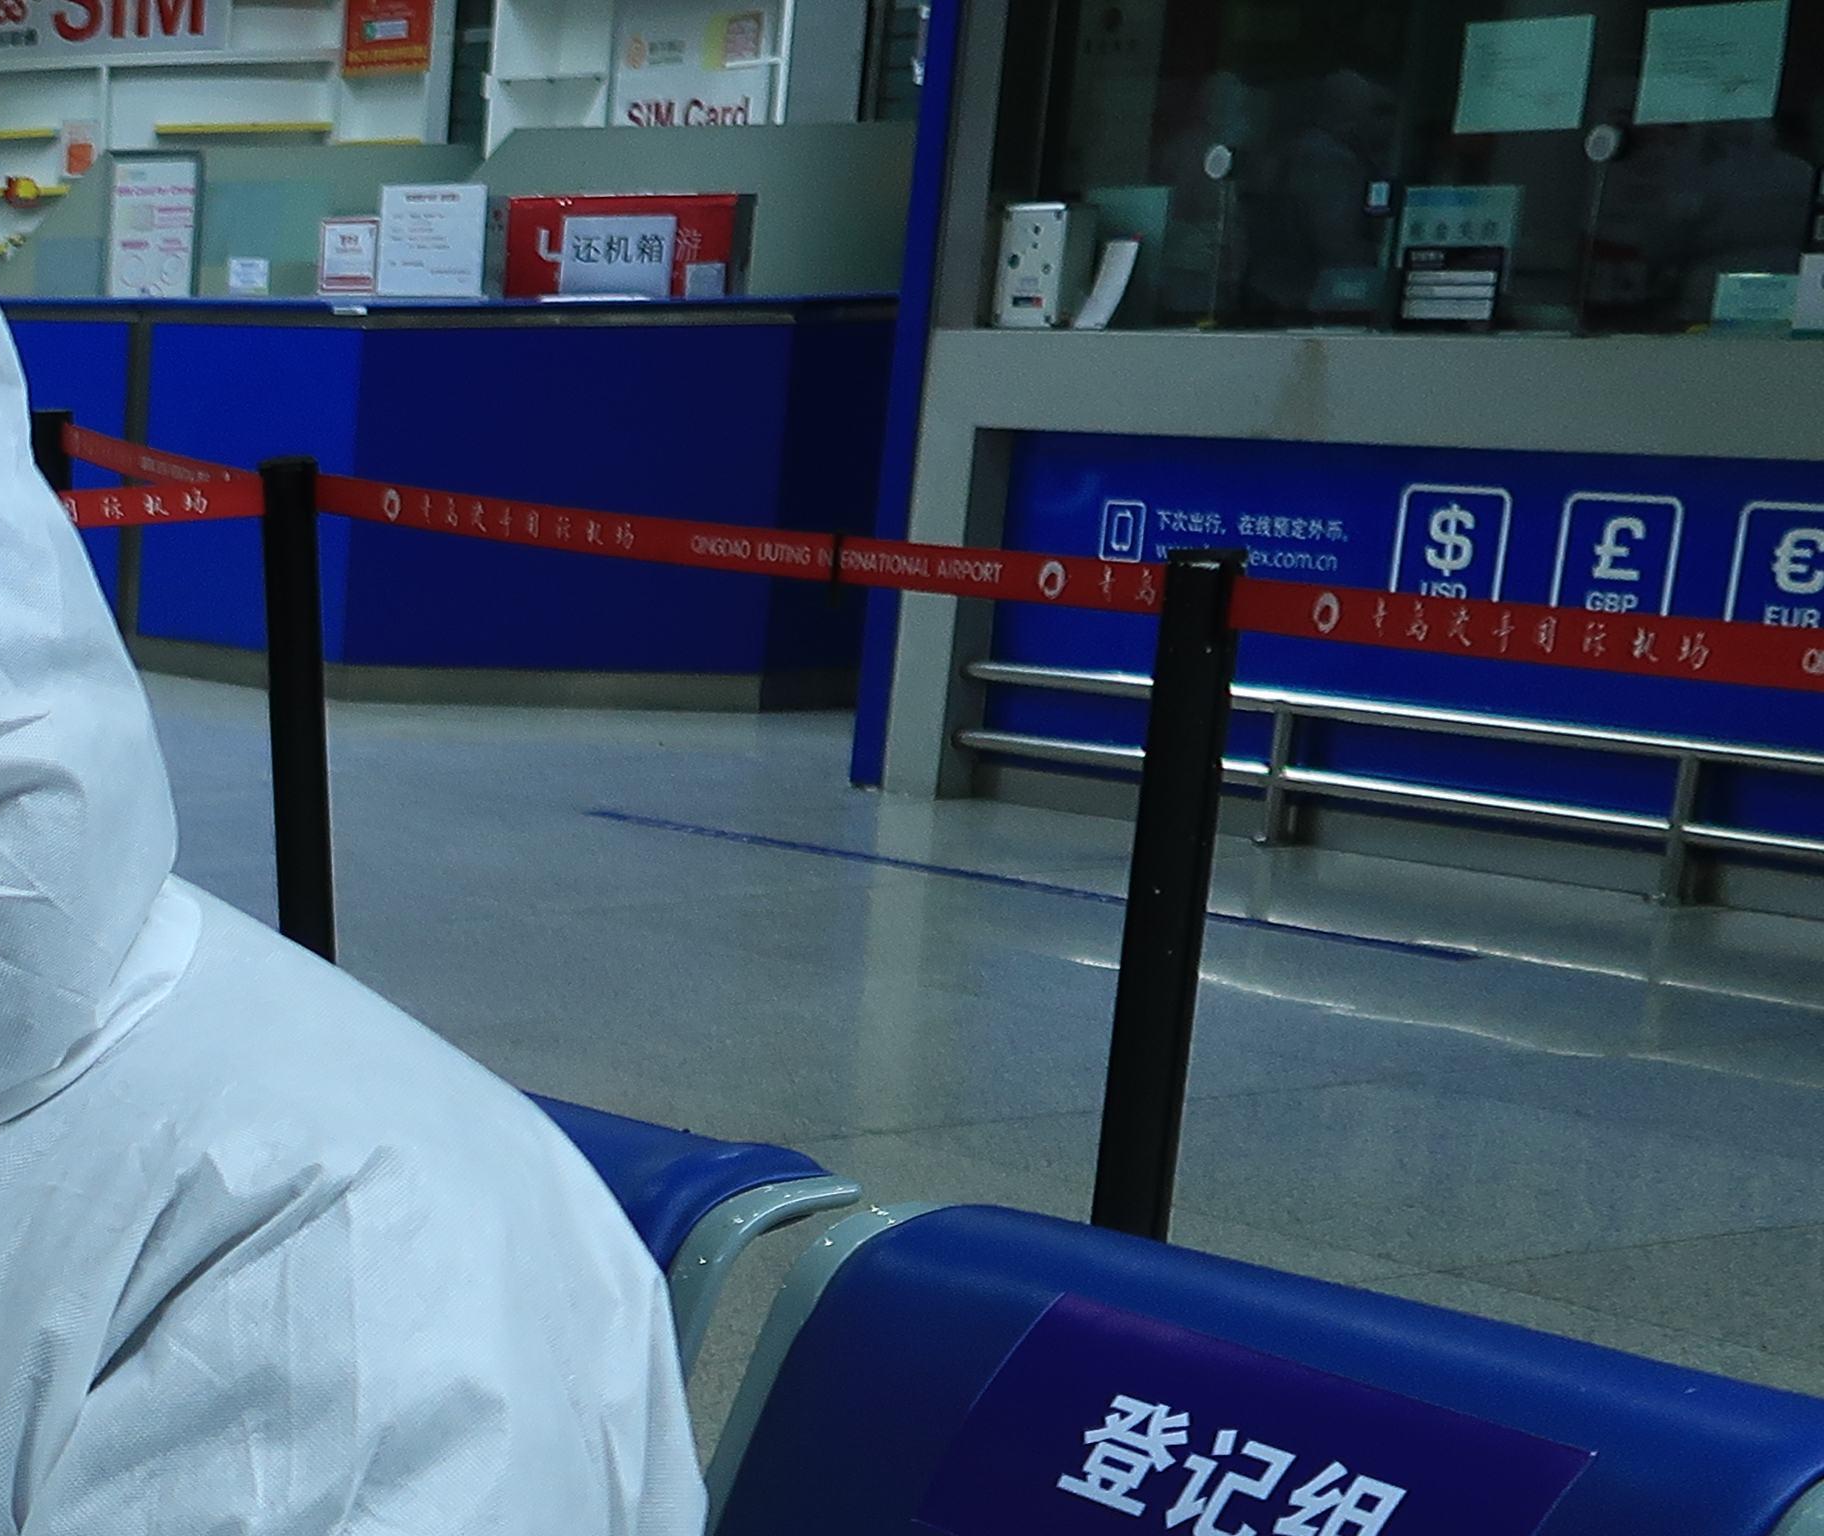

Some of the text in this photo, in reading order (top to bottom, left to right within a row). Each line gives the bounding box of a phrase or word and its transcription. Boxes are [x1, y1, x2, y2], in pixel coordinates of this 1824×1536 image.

[572, 233, 666, 264] 还机箱
[690, 533, 750, 560] QINGDAO
[937, 555, 1004, 584] AIRPORT
[1425, 503, 1476, 577] $
[1592, 516, 1647, 582] £
[1585, 591, 1639, 614] GBP
[1763, 604, 1822, 630] EUR
